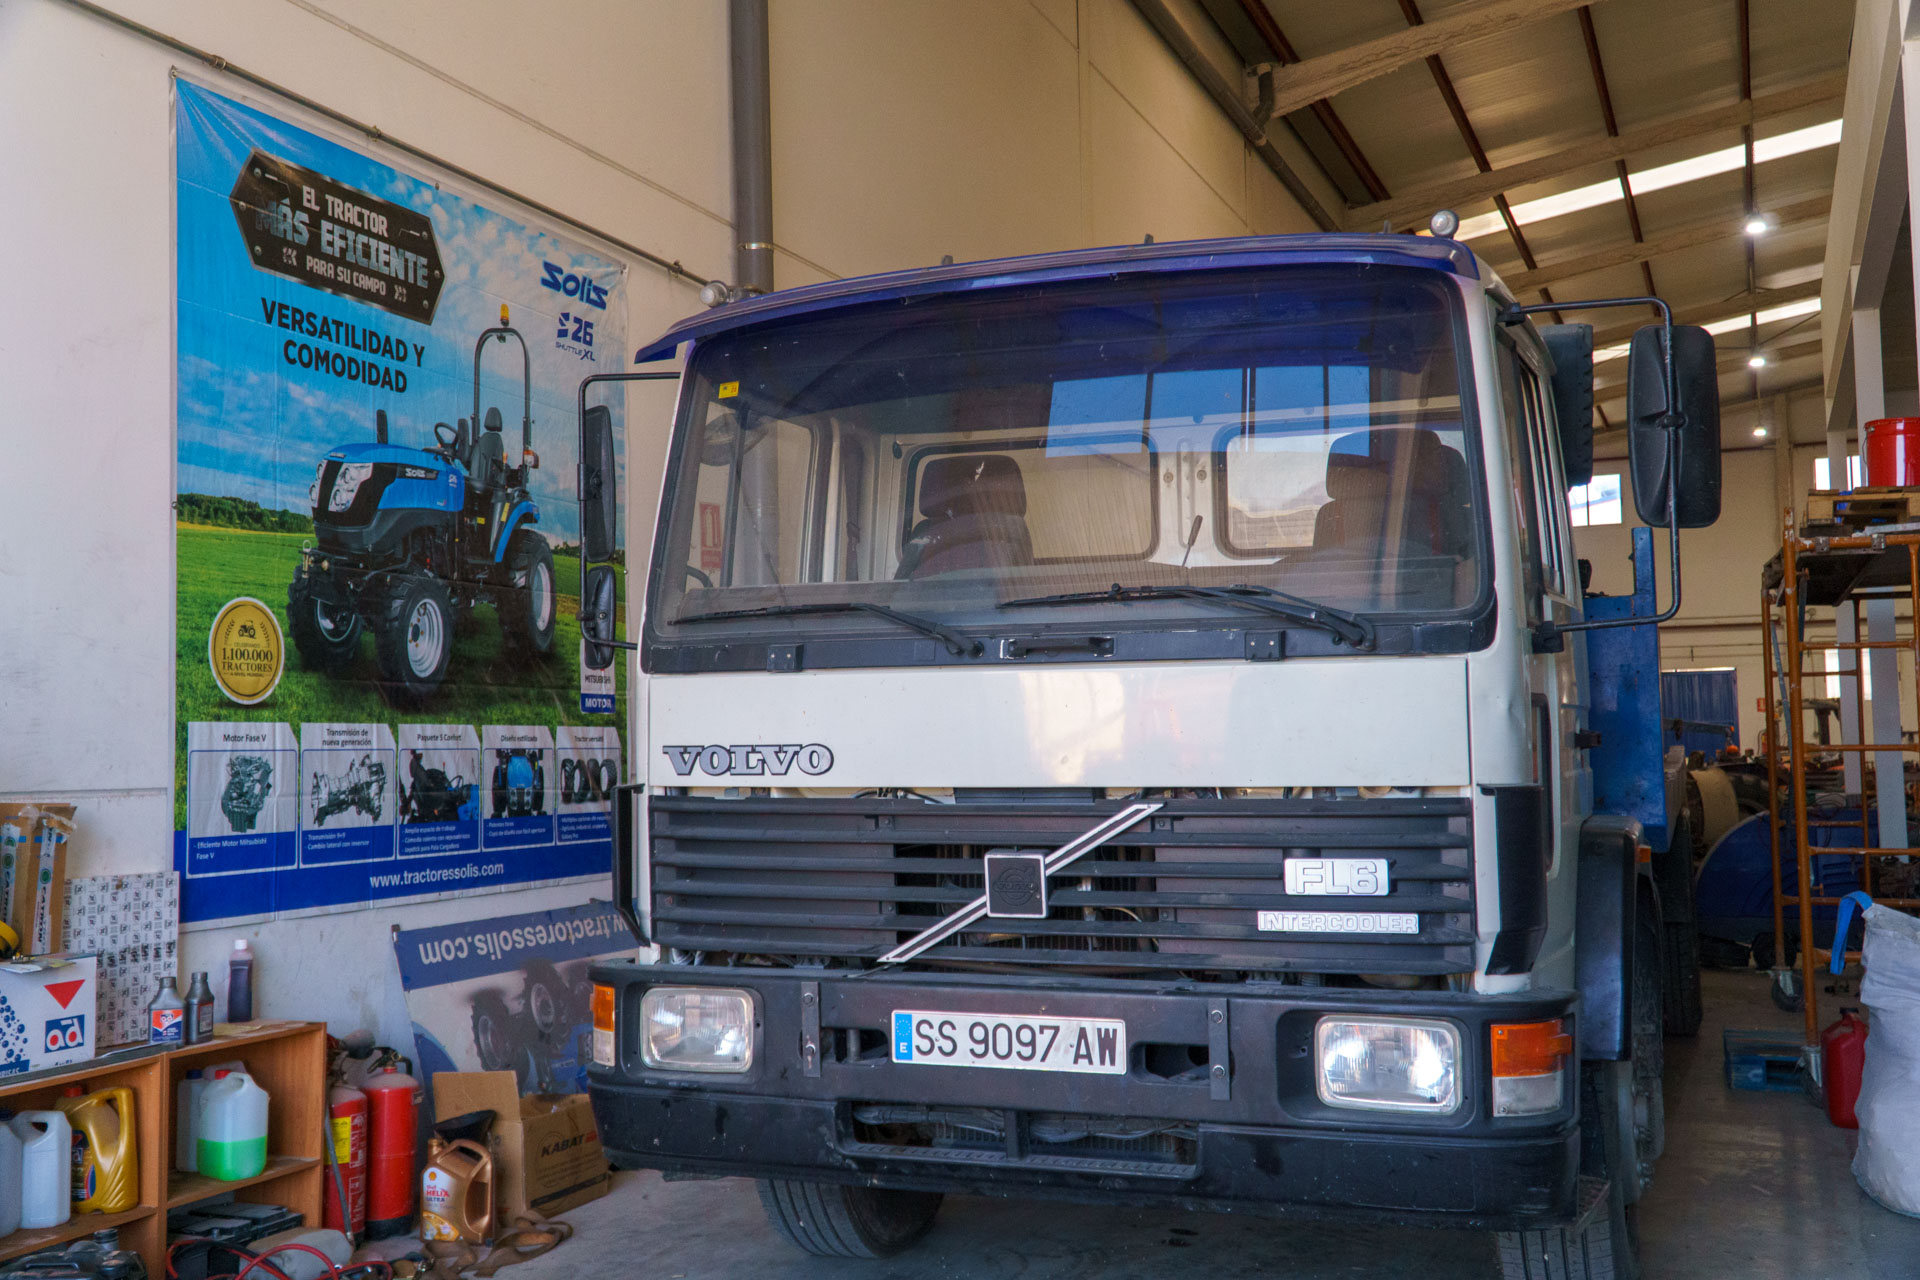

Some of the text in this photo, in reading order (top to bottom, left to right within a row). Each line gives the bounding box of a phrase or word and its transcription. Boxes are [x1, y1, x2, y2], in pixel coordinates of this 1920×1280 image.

[302, 185, 388, 238] EL TRACTOR
[255, 197, 429, 289] MÁS EFICIENTE
[306, 255, 387, 296] PARA SU CAMPO
[261, 297, 425, 367] VERSATILIDAD Y
[571, 316, 594, 347] 26
[283, 339, 408, 393] COMODIDAD
[222, 647, 273, 663] 1.100.000
[222, 661, 273, 673] TRACTORES
[585, 698, 612, 709] MOTOR
[223, 734, 267, 742] Motor Fase V
[326, 728, 369, 737] Transmisión de
[341, 738, 372, 747] generación
[662, 743, 835, 776] VOLVO
[197, 841, 221, 849] Eficiente
[370, 863, 504, 888] www.tractoressolis.com
[1295, 860, 1379, 895] FL6
[1258, 912, 1418, 934] INTERCOOLER
[46, 1017, 83, 1051] ad
[915, 1019, 1118, 1067] SS 9097 AW
[900, 1042, 908, 1053] E
[541, 1134, 585, 1157] KABAT
[426, 1189, 449, 1197] HELIX
